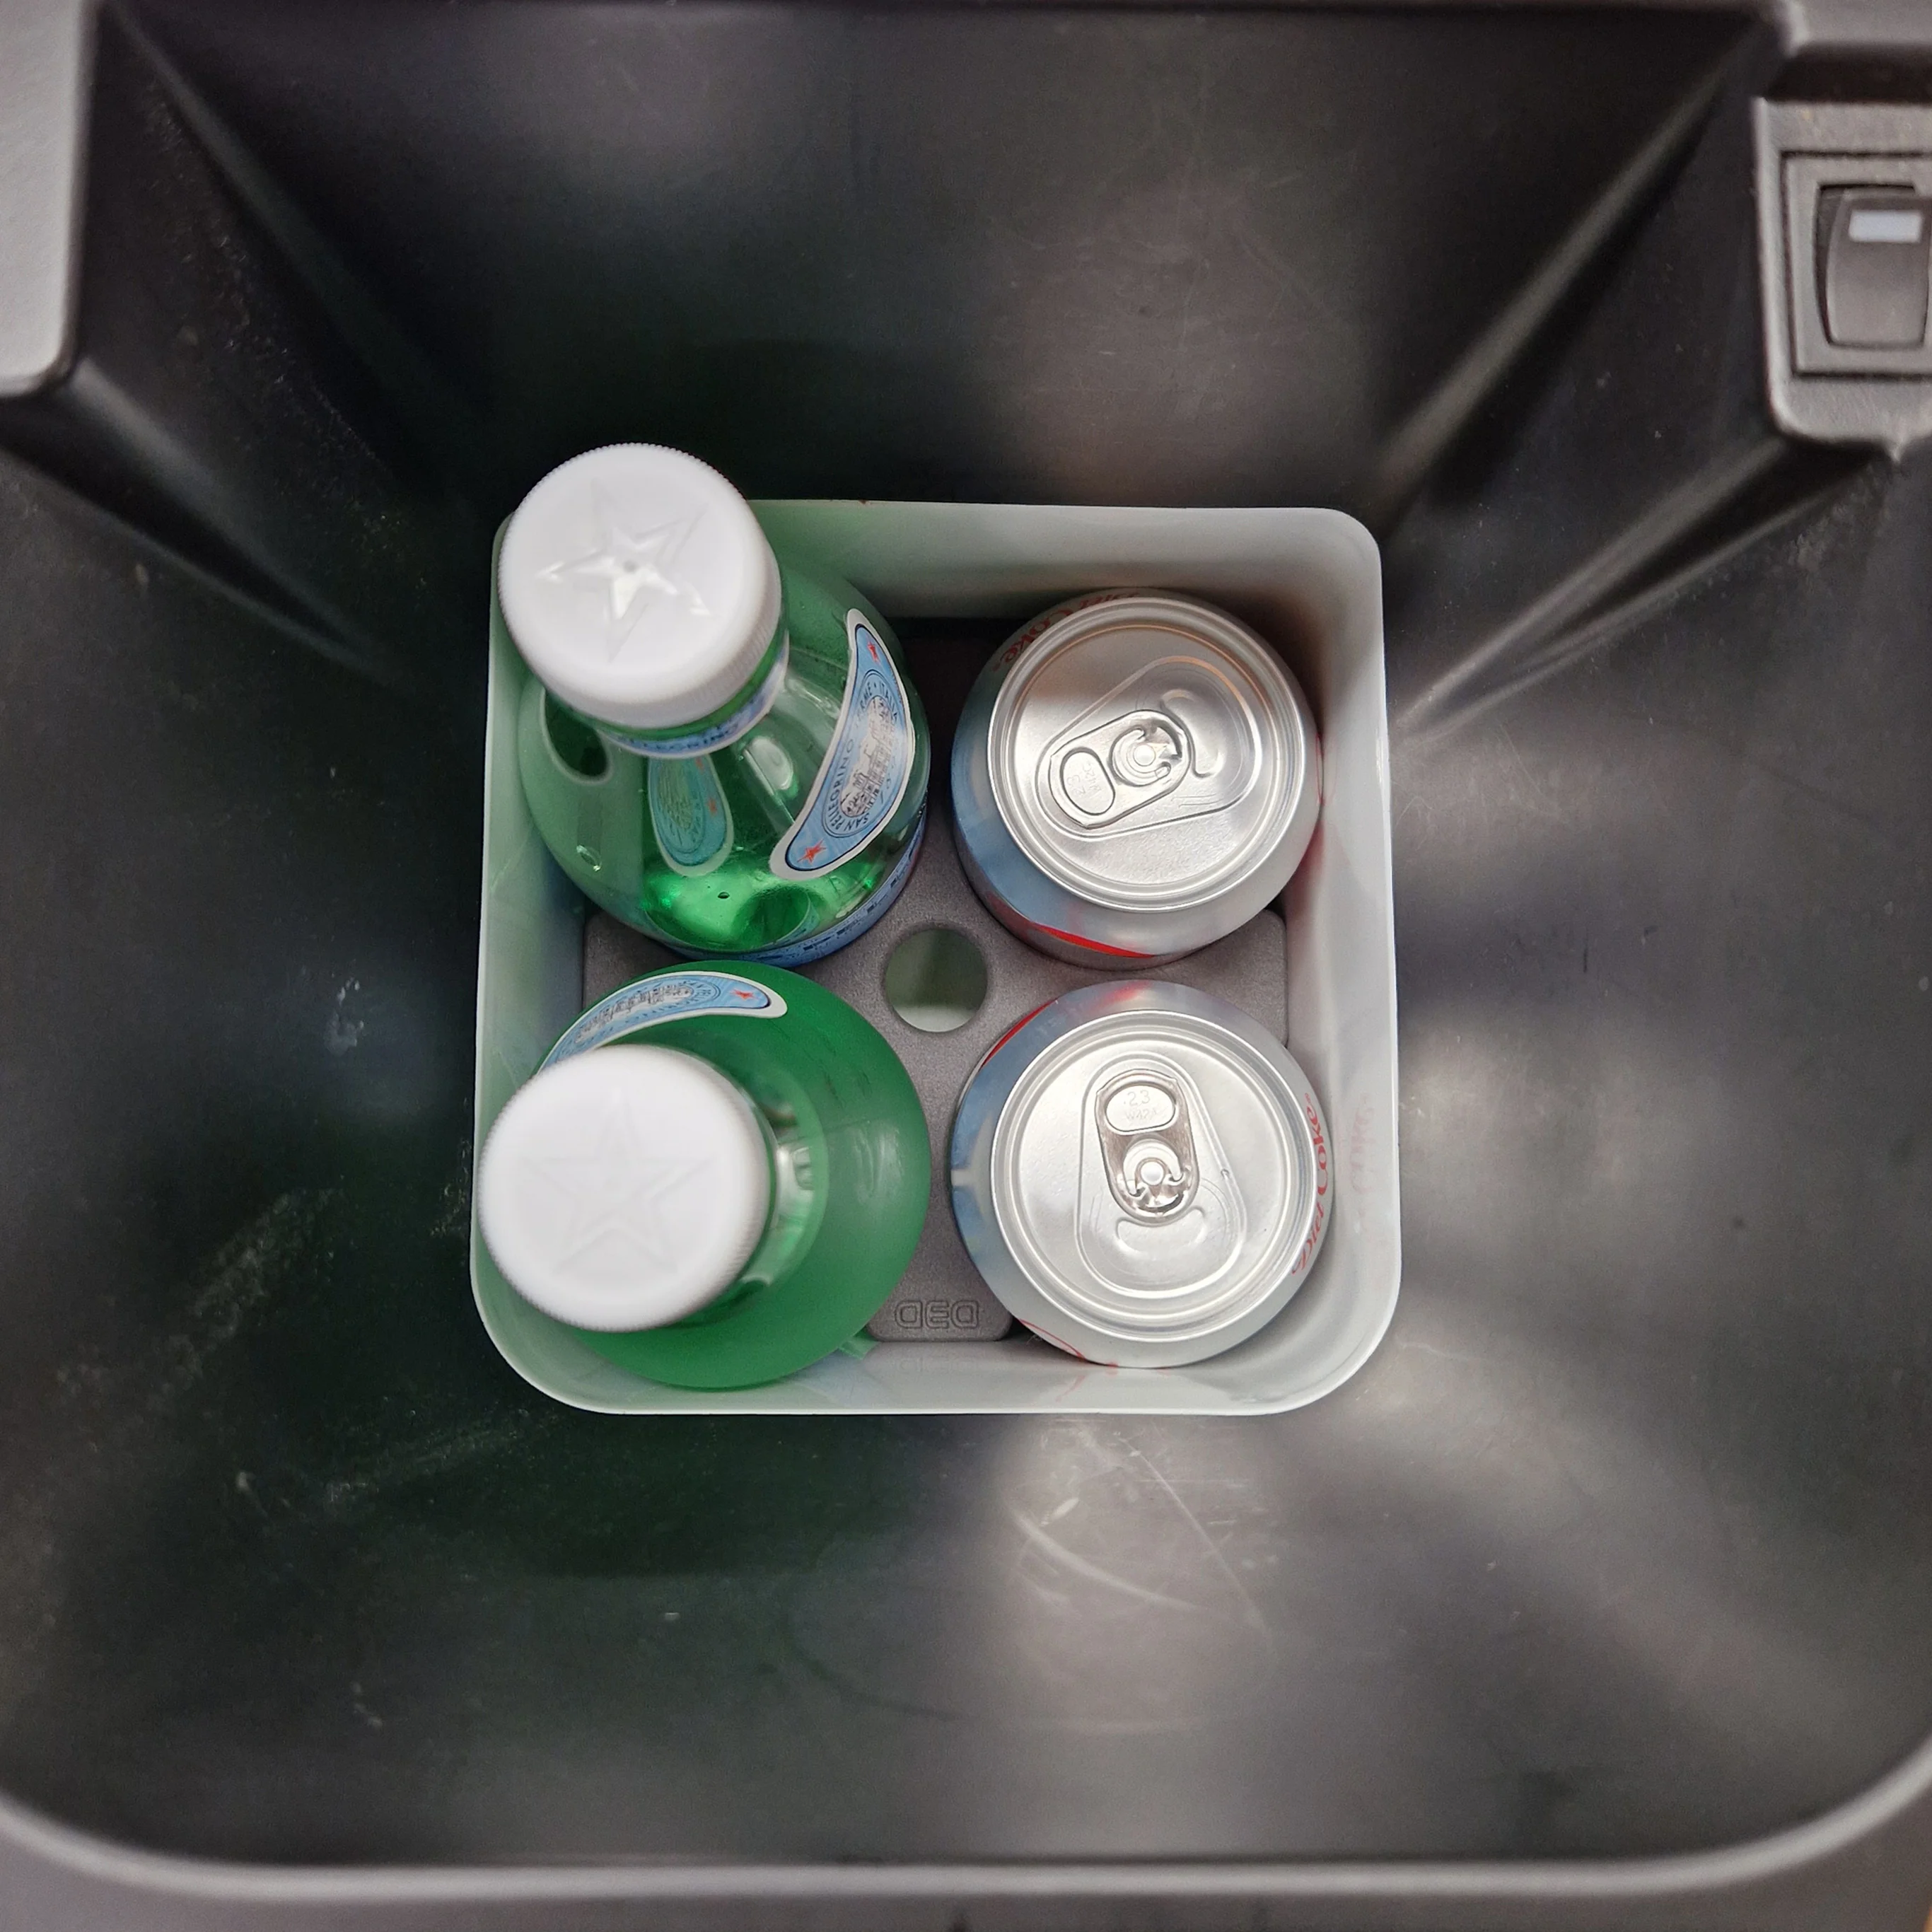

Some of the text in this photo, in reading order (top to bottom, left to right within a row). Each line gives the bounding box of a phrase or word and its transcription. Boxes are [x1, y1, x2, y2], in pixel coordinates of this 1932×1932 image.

[827, 738, 854, 832] PELLEGRINO
[845, 813, 869, 832] SAN
[1291, 1105, 1328, 1274] Diet Coke
[894, 1300, 979, 1329] D3D
